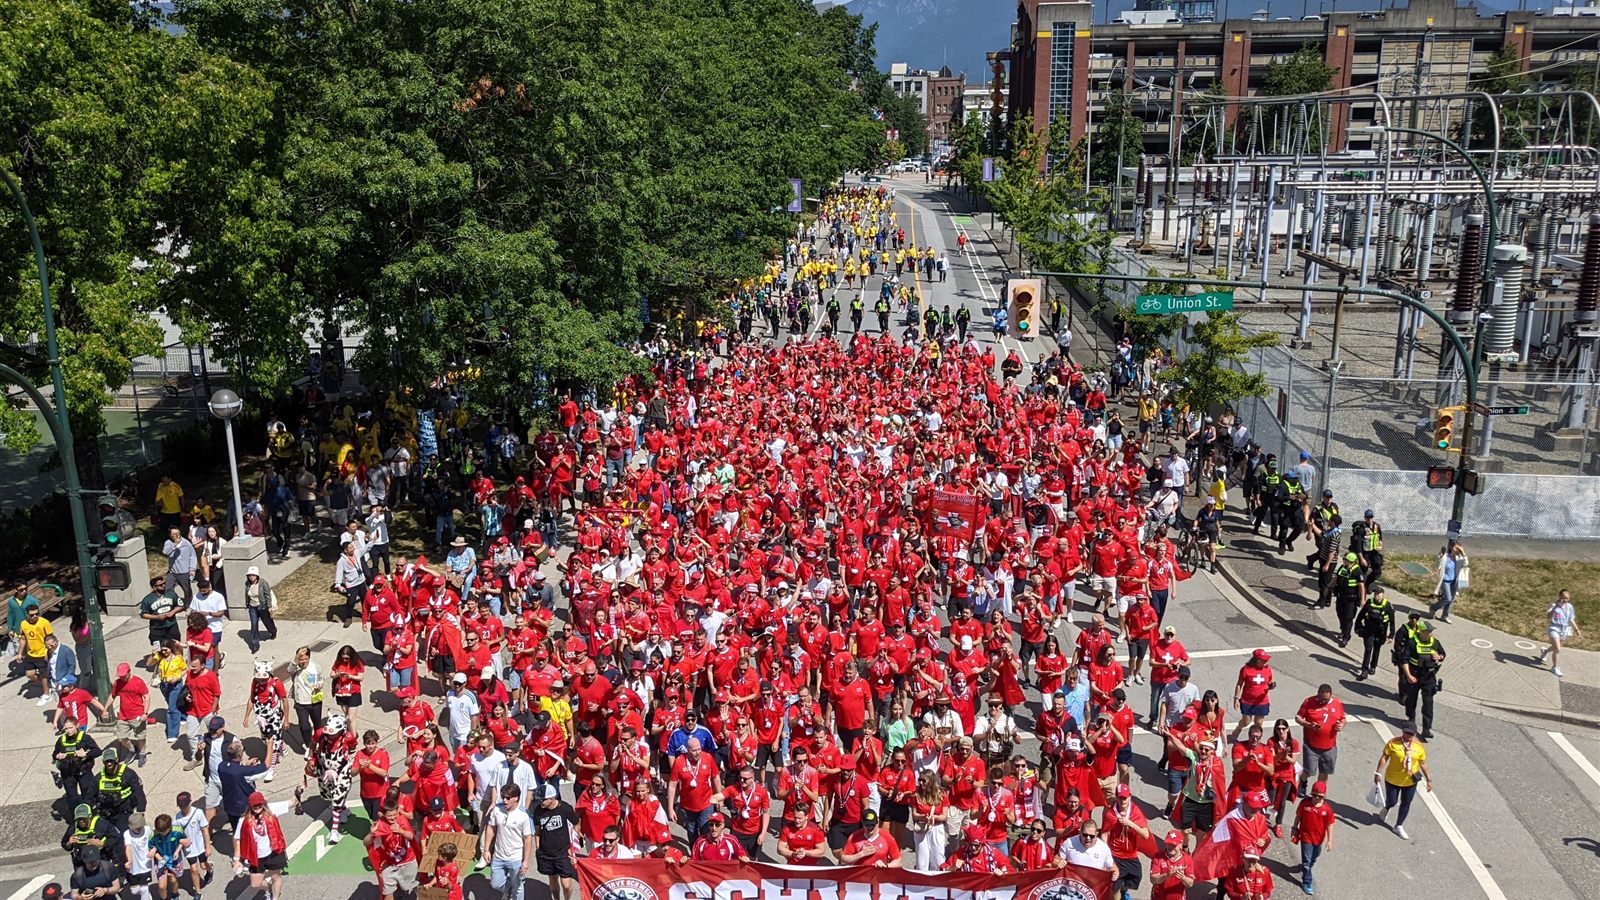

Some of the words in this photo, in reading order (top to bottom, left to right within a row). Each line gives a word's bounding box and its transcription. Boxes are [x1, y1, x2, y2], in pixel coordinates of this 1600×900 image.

[1168, 296, 1201, 309] Union
[1206, 296, 1222, 307] St.
[482, 630, 490, 639] 23
[1323, 713, 1328, 723] 7
